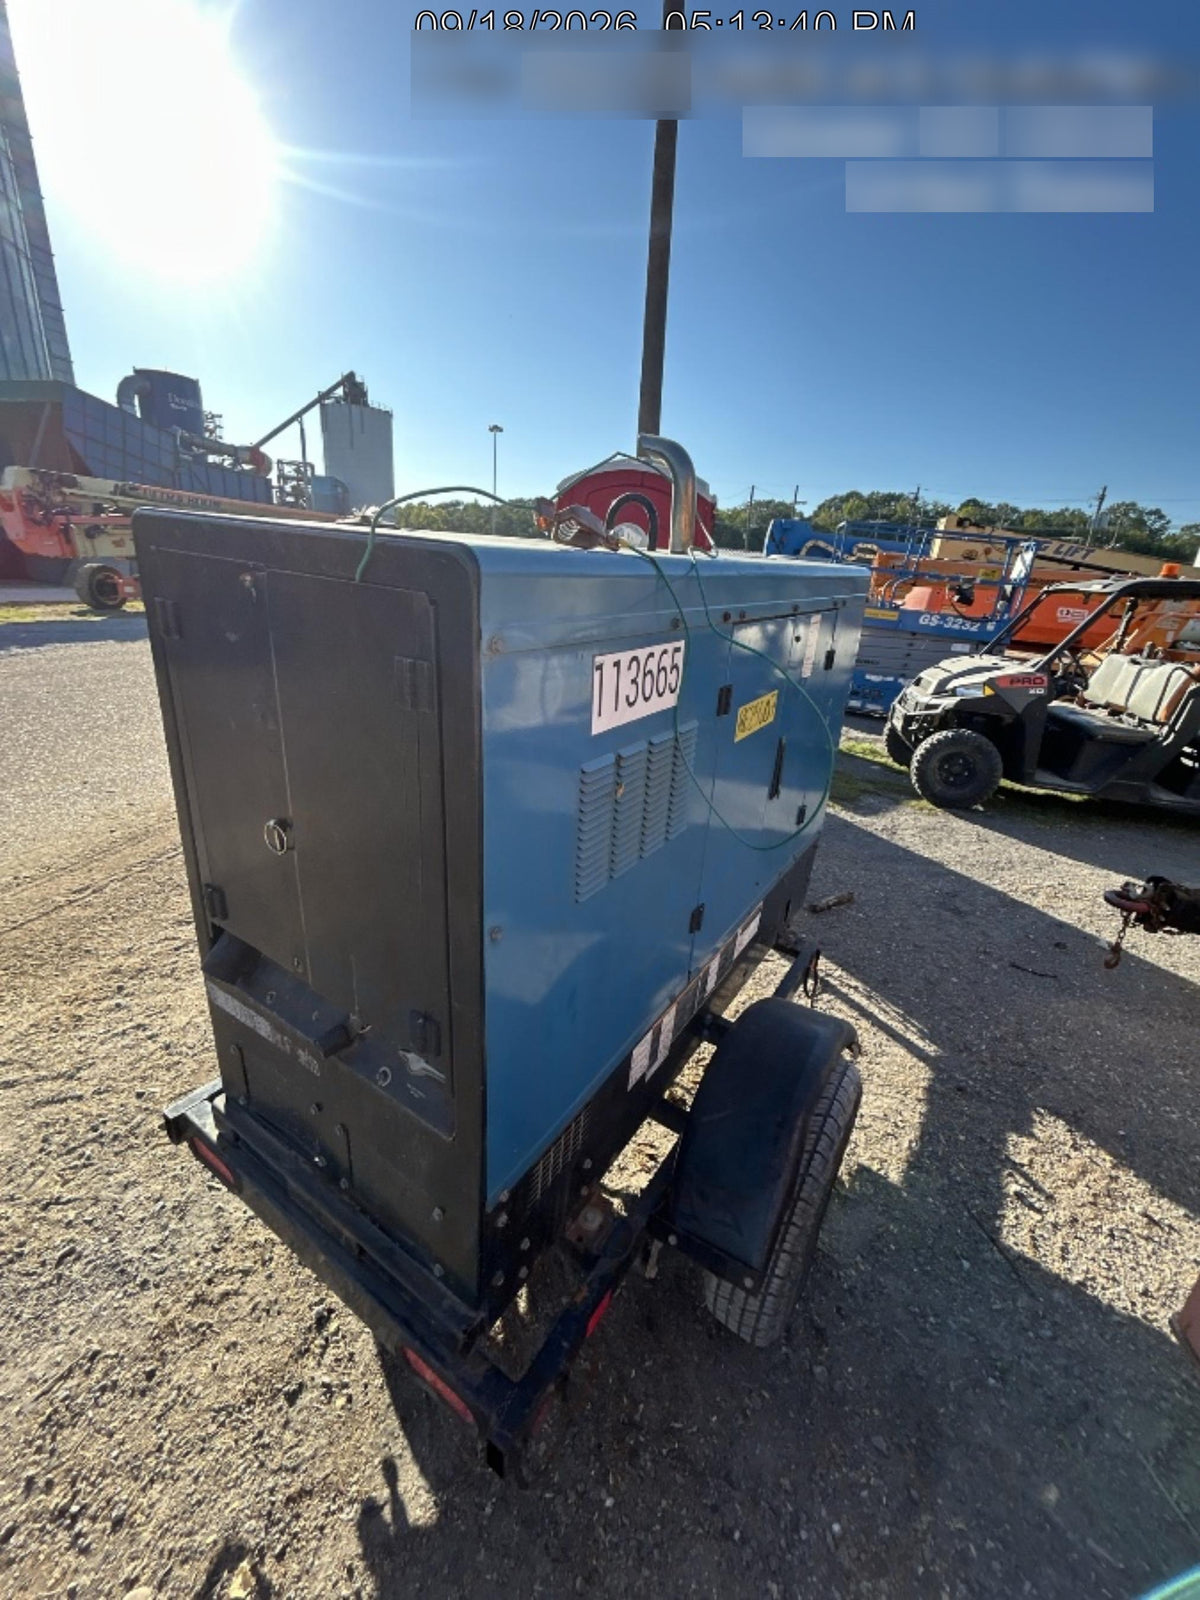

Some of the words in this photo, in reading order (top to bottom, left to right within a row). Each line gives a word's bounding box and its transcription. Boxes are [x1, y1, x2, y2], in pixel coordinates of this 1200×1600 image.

[1053, 543, 1096, 561] LIFT
[919, 613, 980, 631] GS-3232
[595, 646, 681, 717] 113665
[1010, 677, 1044, 686] PRO
